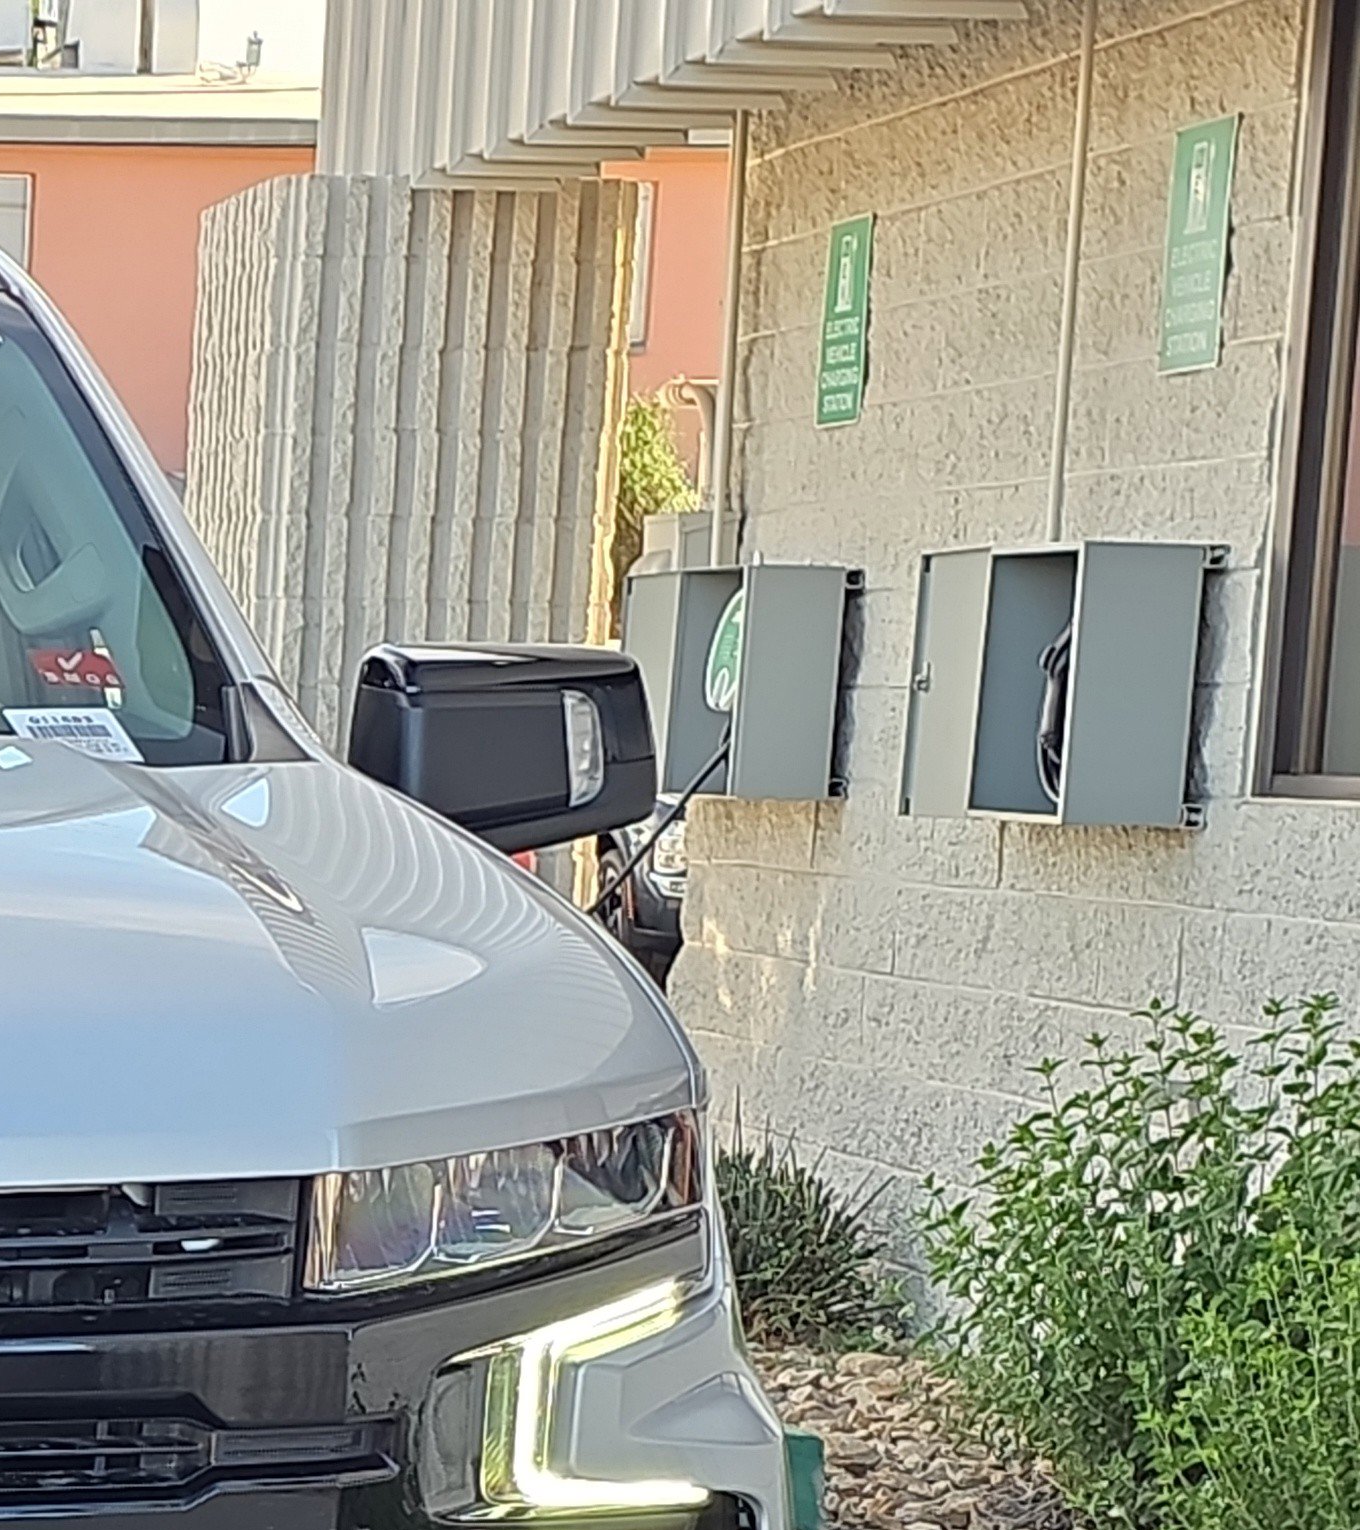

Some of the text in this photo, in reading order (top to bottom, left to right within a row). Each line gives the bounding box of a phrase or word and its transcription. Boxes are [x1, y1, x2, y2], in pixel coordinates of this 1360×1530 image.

[1170, 239, 1218, 269] ELECTRIC
[1171, 269, 1212, 298] VEHICLE
[826, 316, 860, 340] ELECTRIC
[825, 342, 857, 364] VEHICLE
[1166, 330, 1208, 358] STATION
[822, 392, 854, 414] STATION
